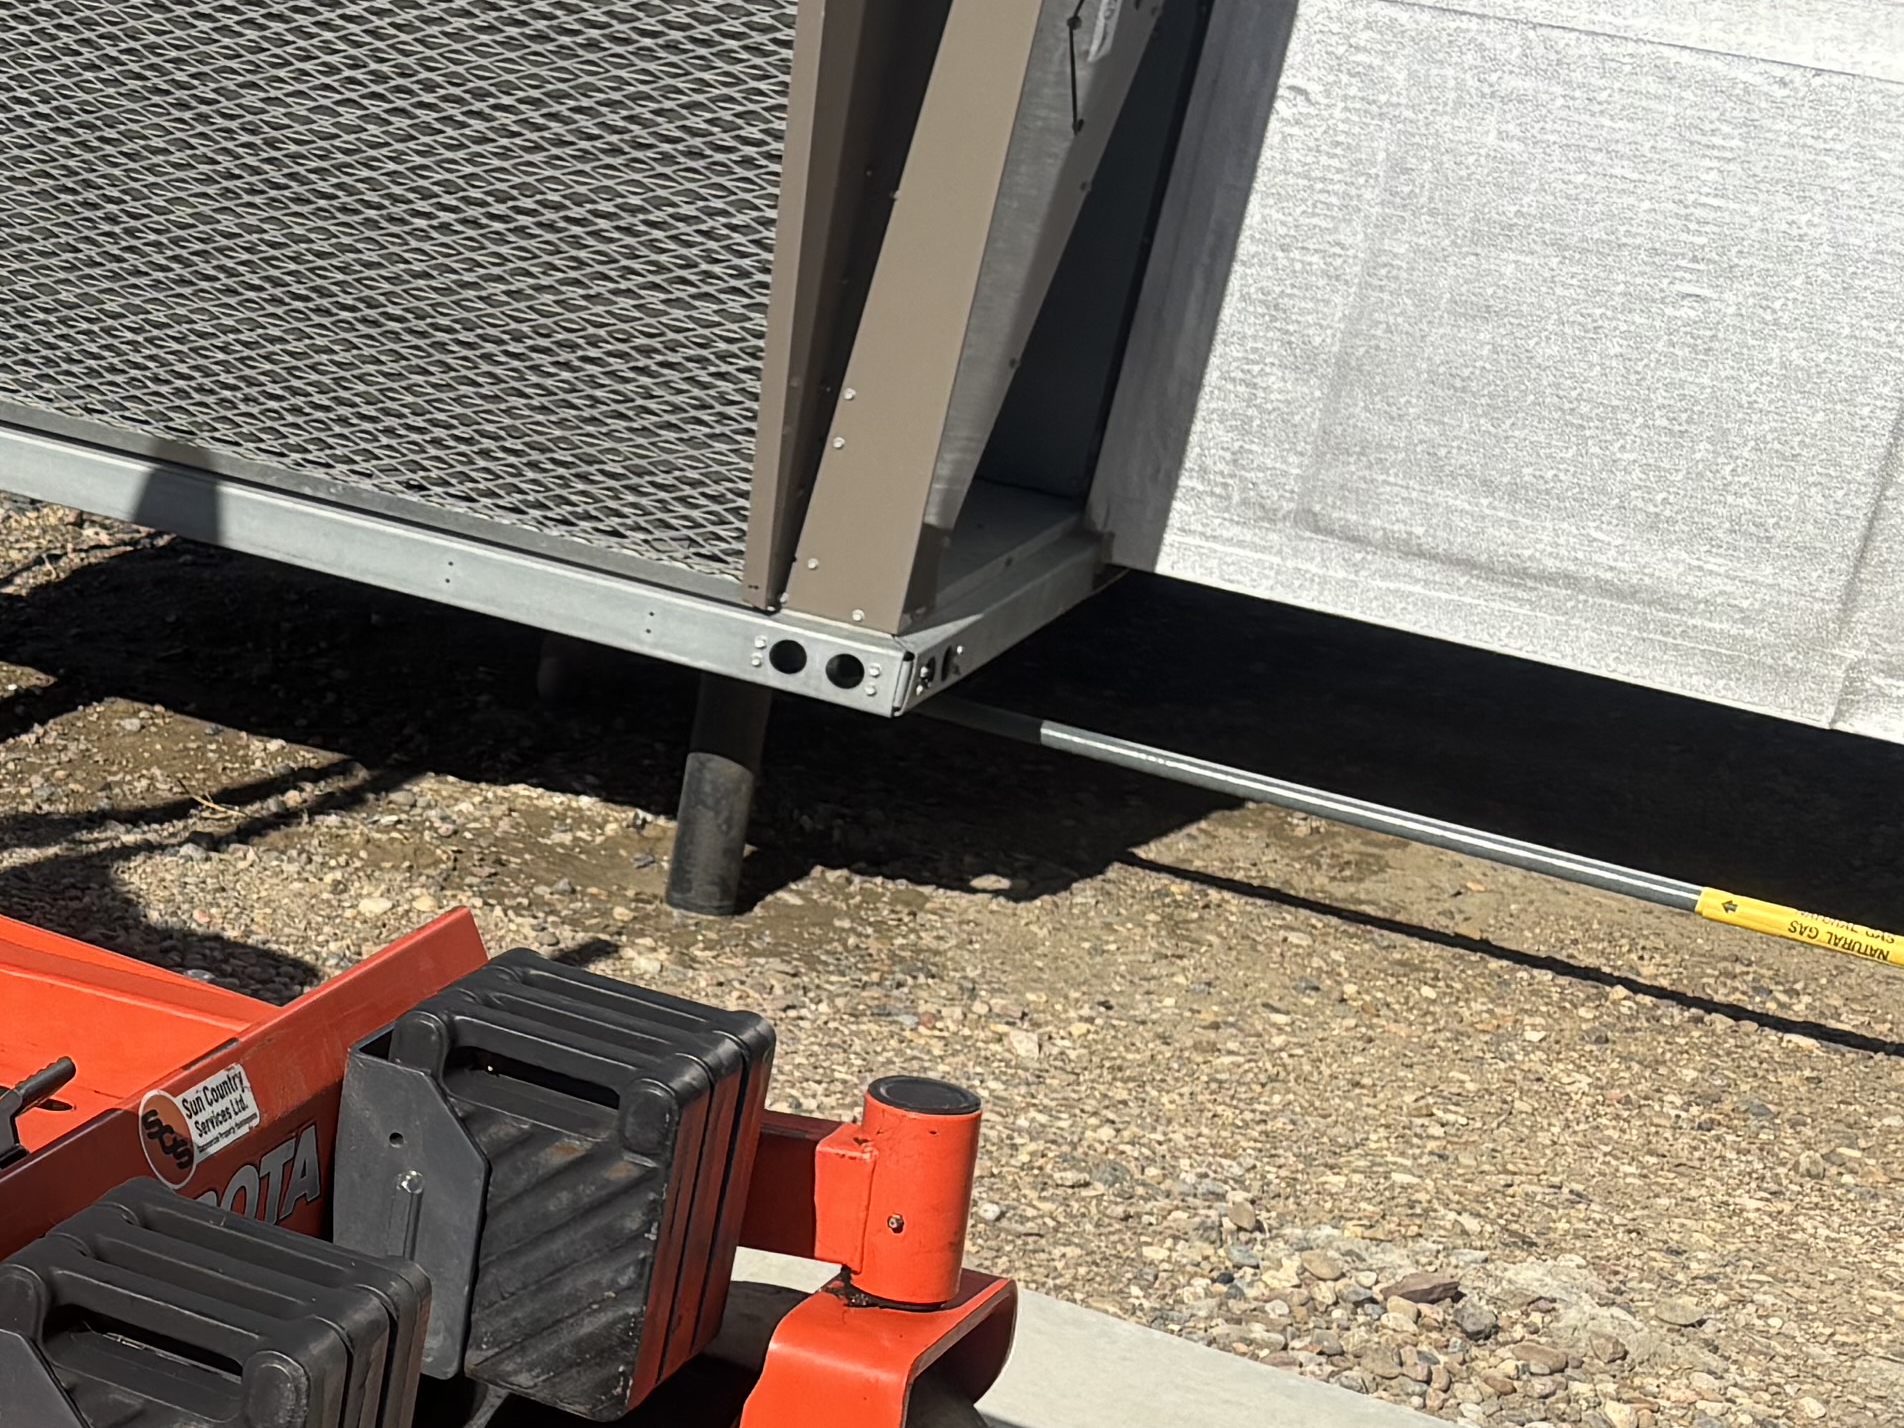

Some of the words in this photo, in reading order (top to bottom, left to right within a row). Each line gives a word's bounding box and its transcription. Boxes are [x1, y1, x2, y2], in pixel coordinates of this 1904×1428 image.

[1788, 920, 1819, 940] GAS
[1826, 930, 1890, 961] NATURAL
[181, 1094, 206, 1120] Sun
[202, 1071, 246, 1107] Country
[194, 1106, 233, 1138] Services
[230, 1093, 249, 1116] Ltd.
[195, 1124, 321, 1224] OTA
